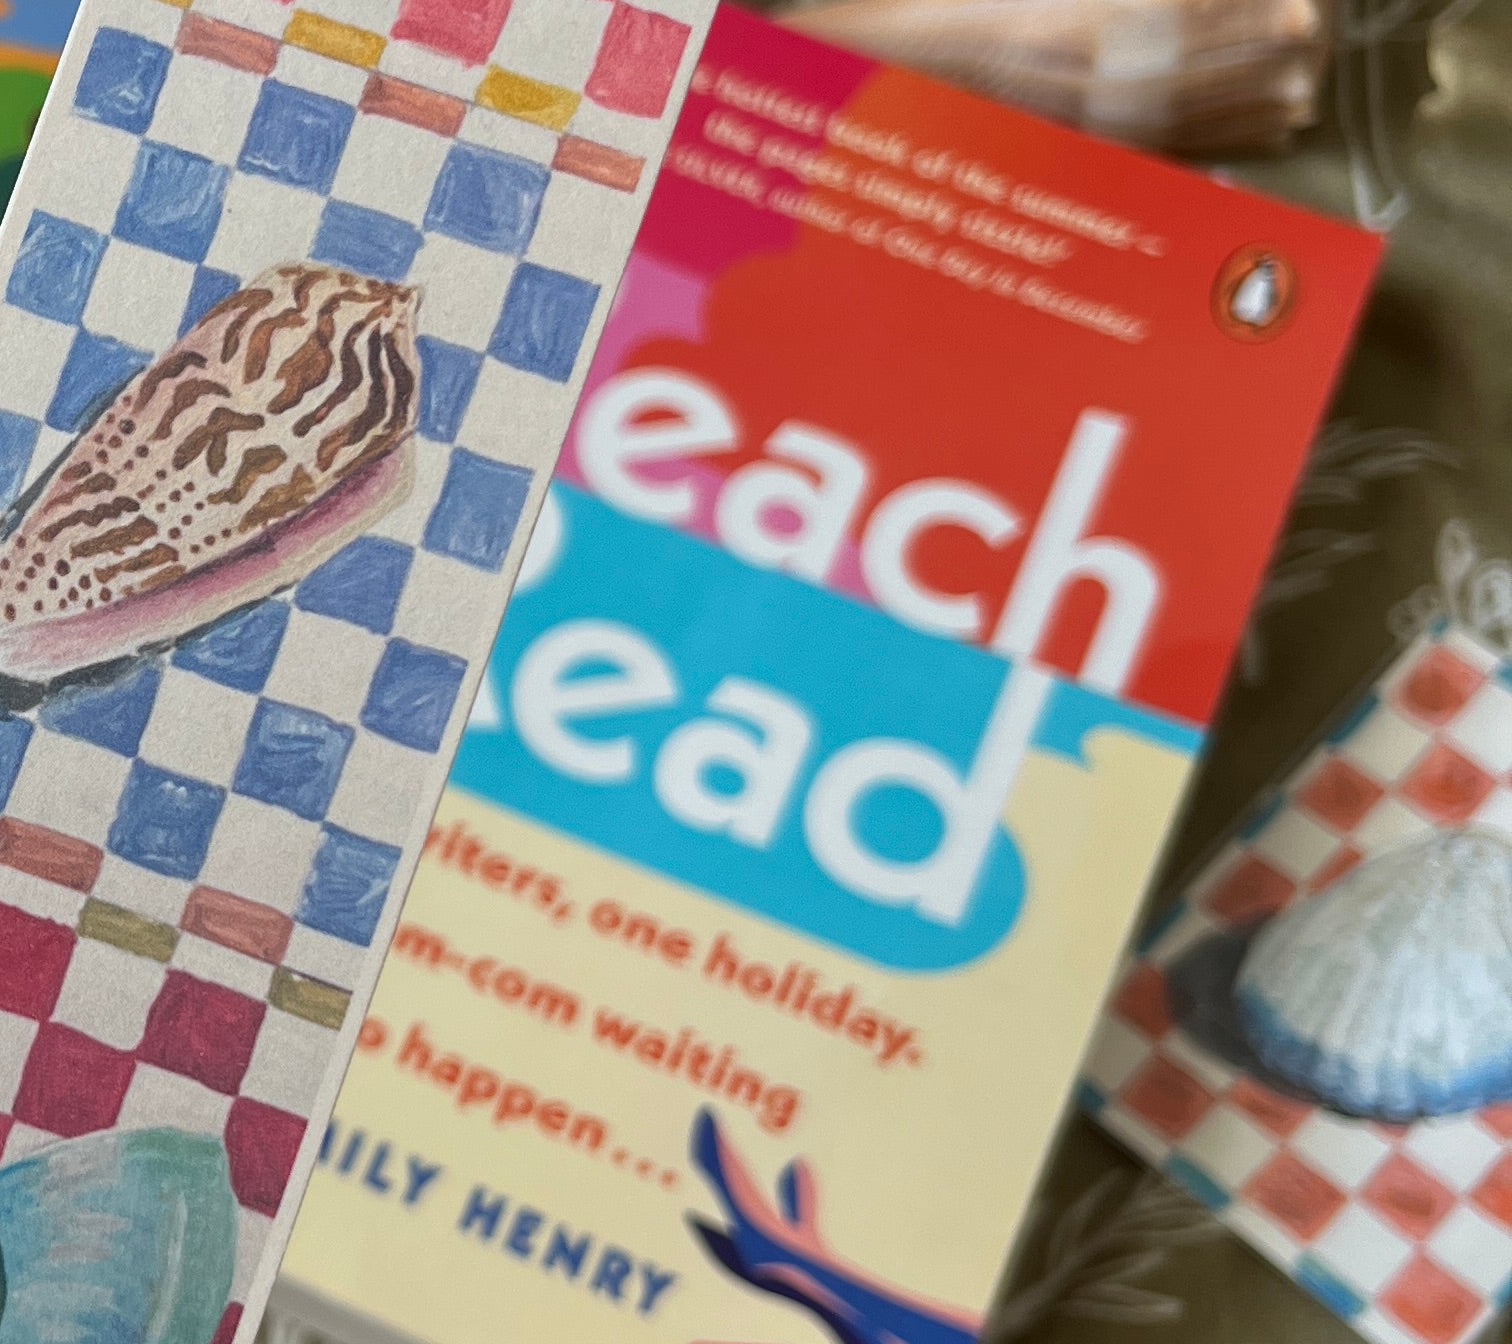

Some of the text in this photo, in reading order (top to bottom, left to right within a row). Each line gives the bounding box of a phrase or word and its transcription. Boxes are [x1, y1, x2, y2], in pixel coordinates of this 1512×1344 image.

[469, 615, 1051, 933] ead
[586, 894, 696, 964] one
[704, 933, 927, 1069] holiday.
[592, 1003, 804, 1133] waiting
[456, 1182, 679, 1324] HENRY
